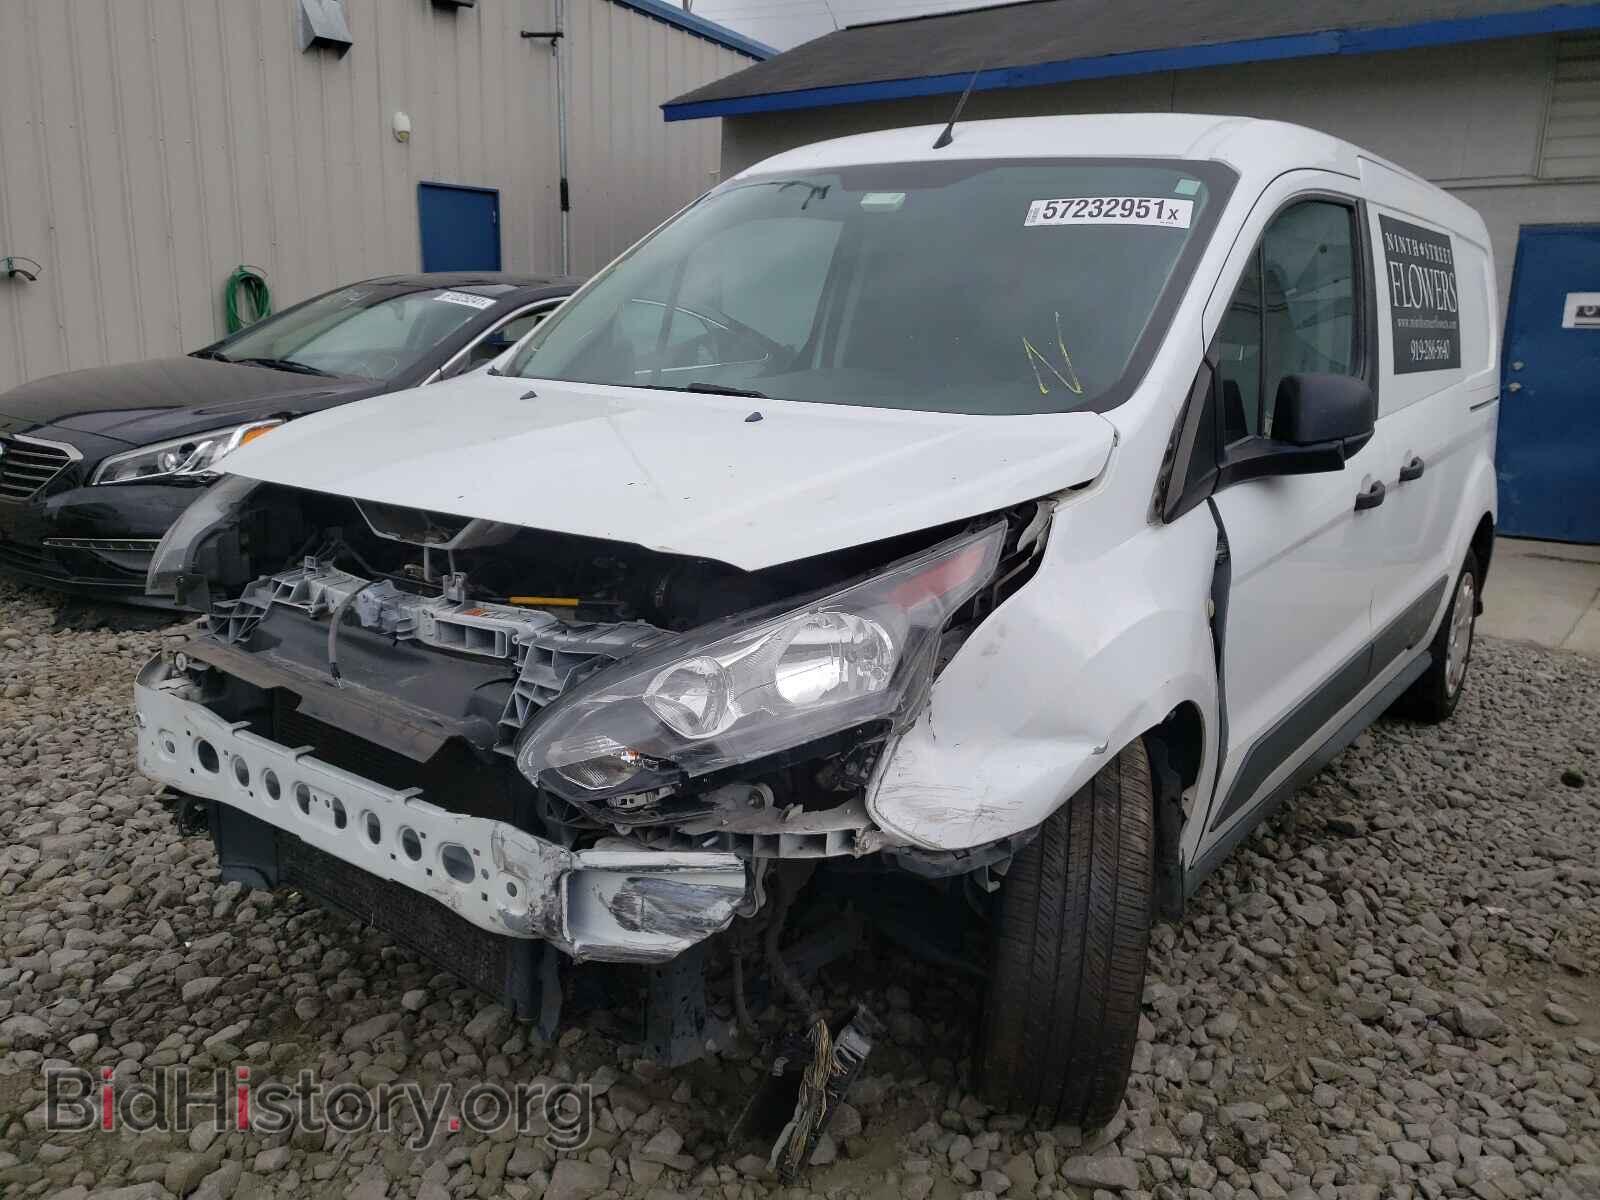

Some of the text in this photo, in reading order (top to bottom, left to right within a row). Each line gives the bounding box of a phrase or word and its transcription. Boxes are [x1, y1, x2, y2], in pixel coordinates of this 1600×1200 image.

[1385, 231, 1453, 265] NINTH STREET
[1388, 260, 1458, 313] FLOWERS
